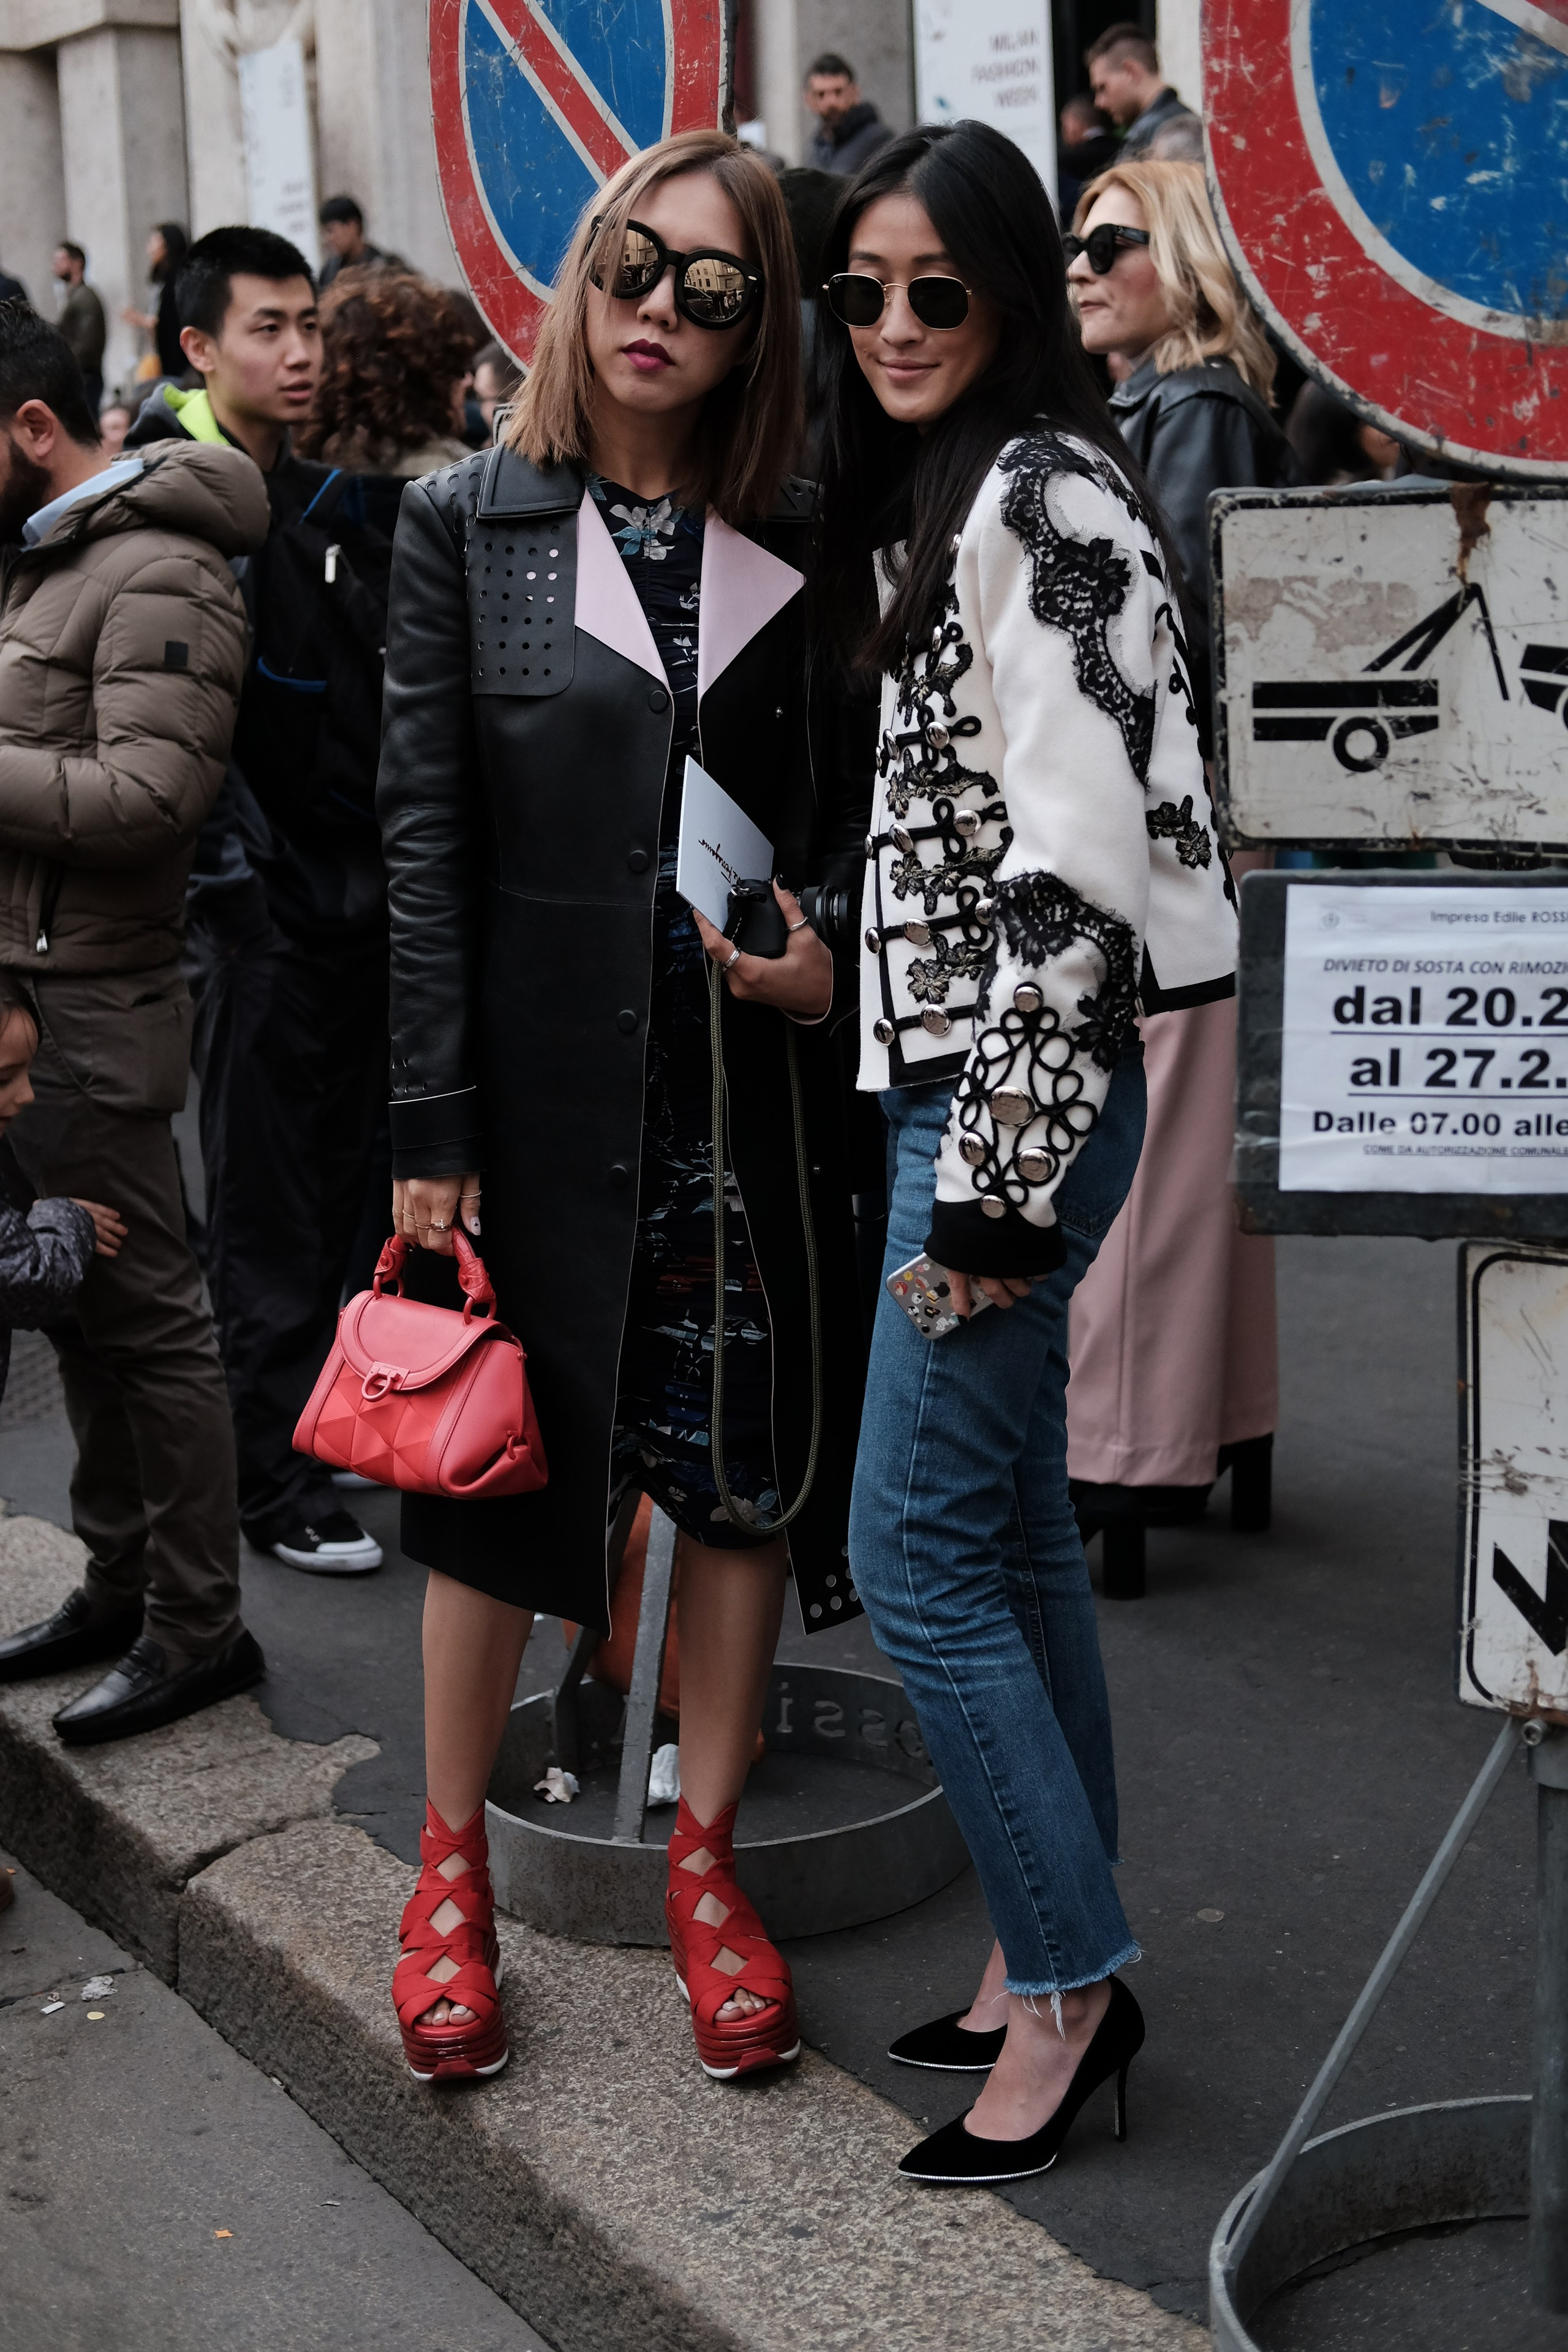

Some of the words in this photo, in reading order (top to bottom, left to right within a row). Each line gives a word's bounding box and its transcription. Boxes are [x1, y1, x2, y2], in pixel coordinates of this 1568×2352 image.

[1431, 911, 1489, 924] Impresa
[1494, 911, 1526, 922] Edile
[1323, 959, 1388, 973] DIVIETO
[1393, 960, 1410, 973] DI
[1414, 960, 1464, 973] SOSTA
[1471, 961, 1504, 974] CON
[1334, 986, 1421, 1025] dal
[1446, 987, 1568, 1027] 20.2
[1351, 1048, 1400, 1087] al
[1425, 1048, 1567, 1088] 27.2.
[1314, 1110, 1395, 1133] Dalle
[1411, 1112, 1500, 1134] 07.00
[1515, 1114, 1568, 1136] alle
